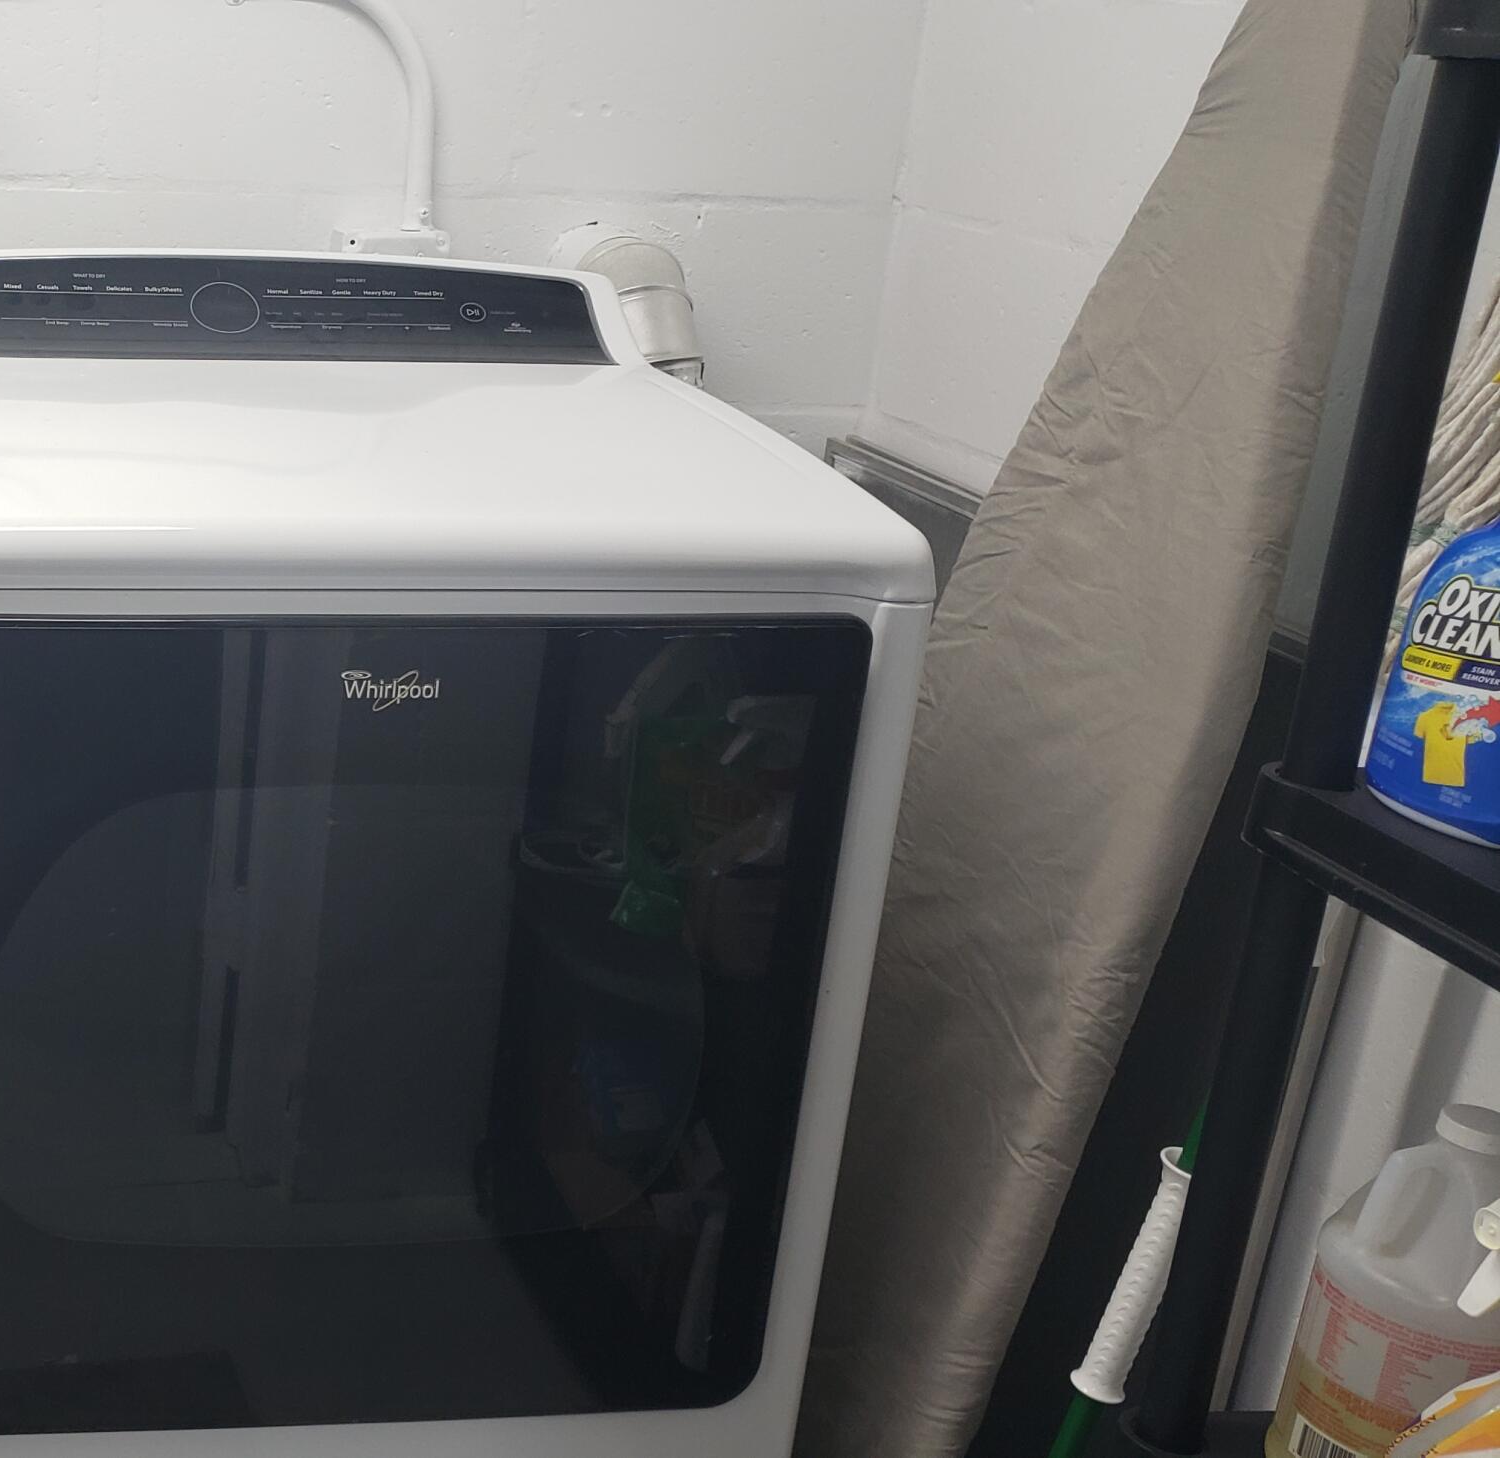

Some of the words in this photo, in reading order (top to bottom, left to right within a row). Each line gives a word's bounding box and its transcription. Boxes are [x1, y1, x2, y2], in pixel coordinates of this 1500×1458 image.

[36, 283, 59, 291] Casuals
[1438, 579, 1500, 623] OXI
[1412, 603, 1500, 659] CLEAN
[1461, 673, 1500, 686] REMOVER
[1471, 666, 1496, 677] STAIN
[342, 672, 440, 708] Whirlpool
